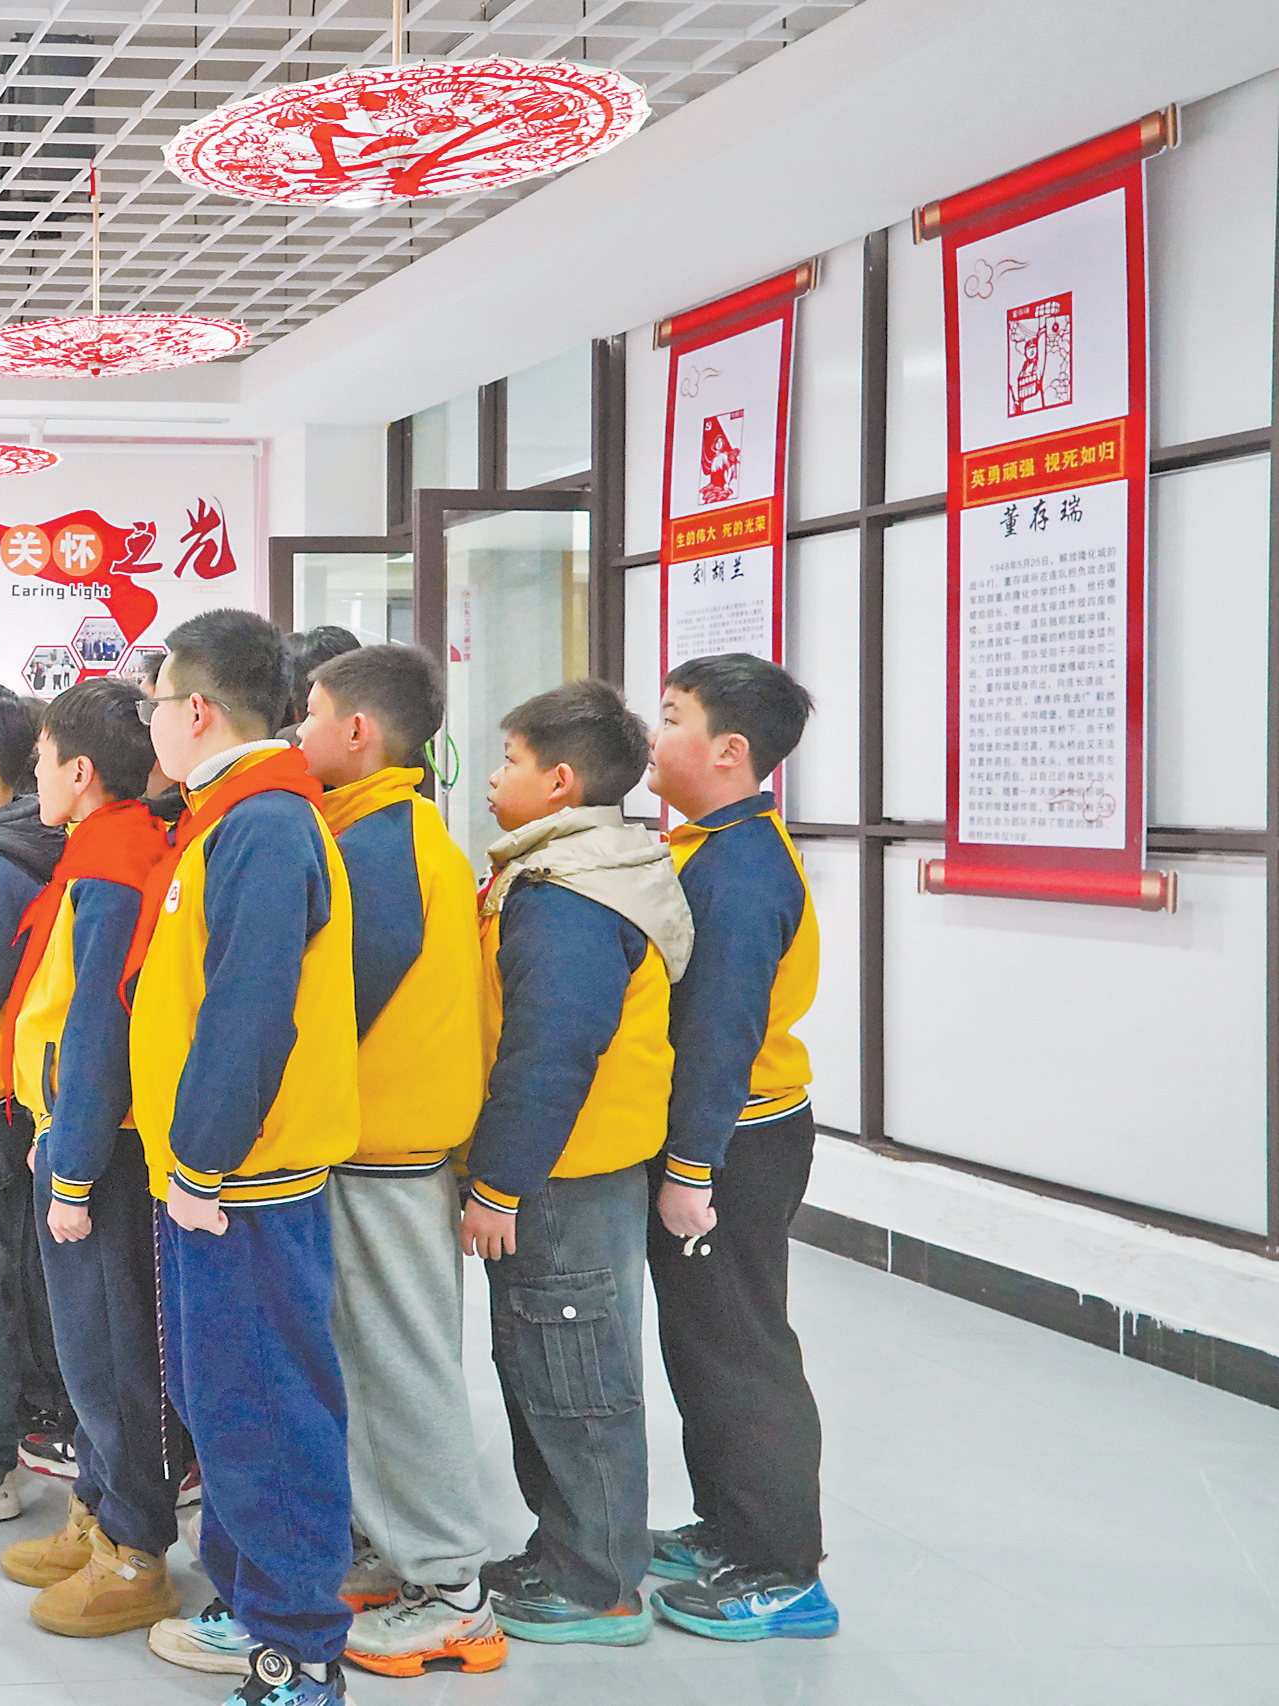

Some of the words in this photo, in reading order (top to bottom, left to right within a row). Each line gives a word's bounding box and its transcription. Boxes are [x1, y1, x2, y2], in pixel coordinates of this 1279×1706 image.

[971, 458, 1035, 488] 英勇顽强
[1045, 441, 1114, 473] 视死如归
[676, 526, 716, 548] 生的伟大
[722, 515, 766, 538] 死的光荣
[1000, 494, 1083, 537] 董存瑞
[8, 495, 238, 580] 关怀之光
[693, 555, 744, 586] 刘胡兰
[11, 584, 65, 600] Caring
[70, 583, 110, 600] Light
